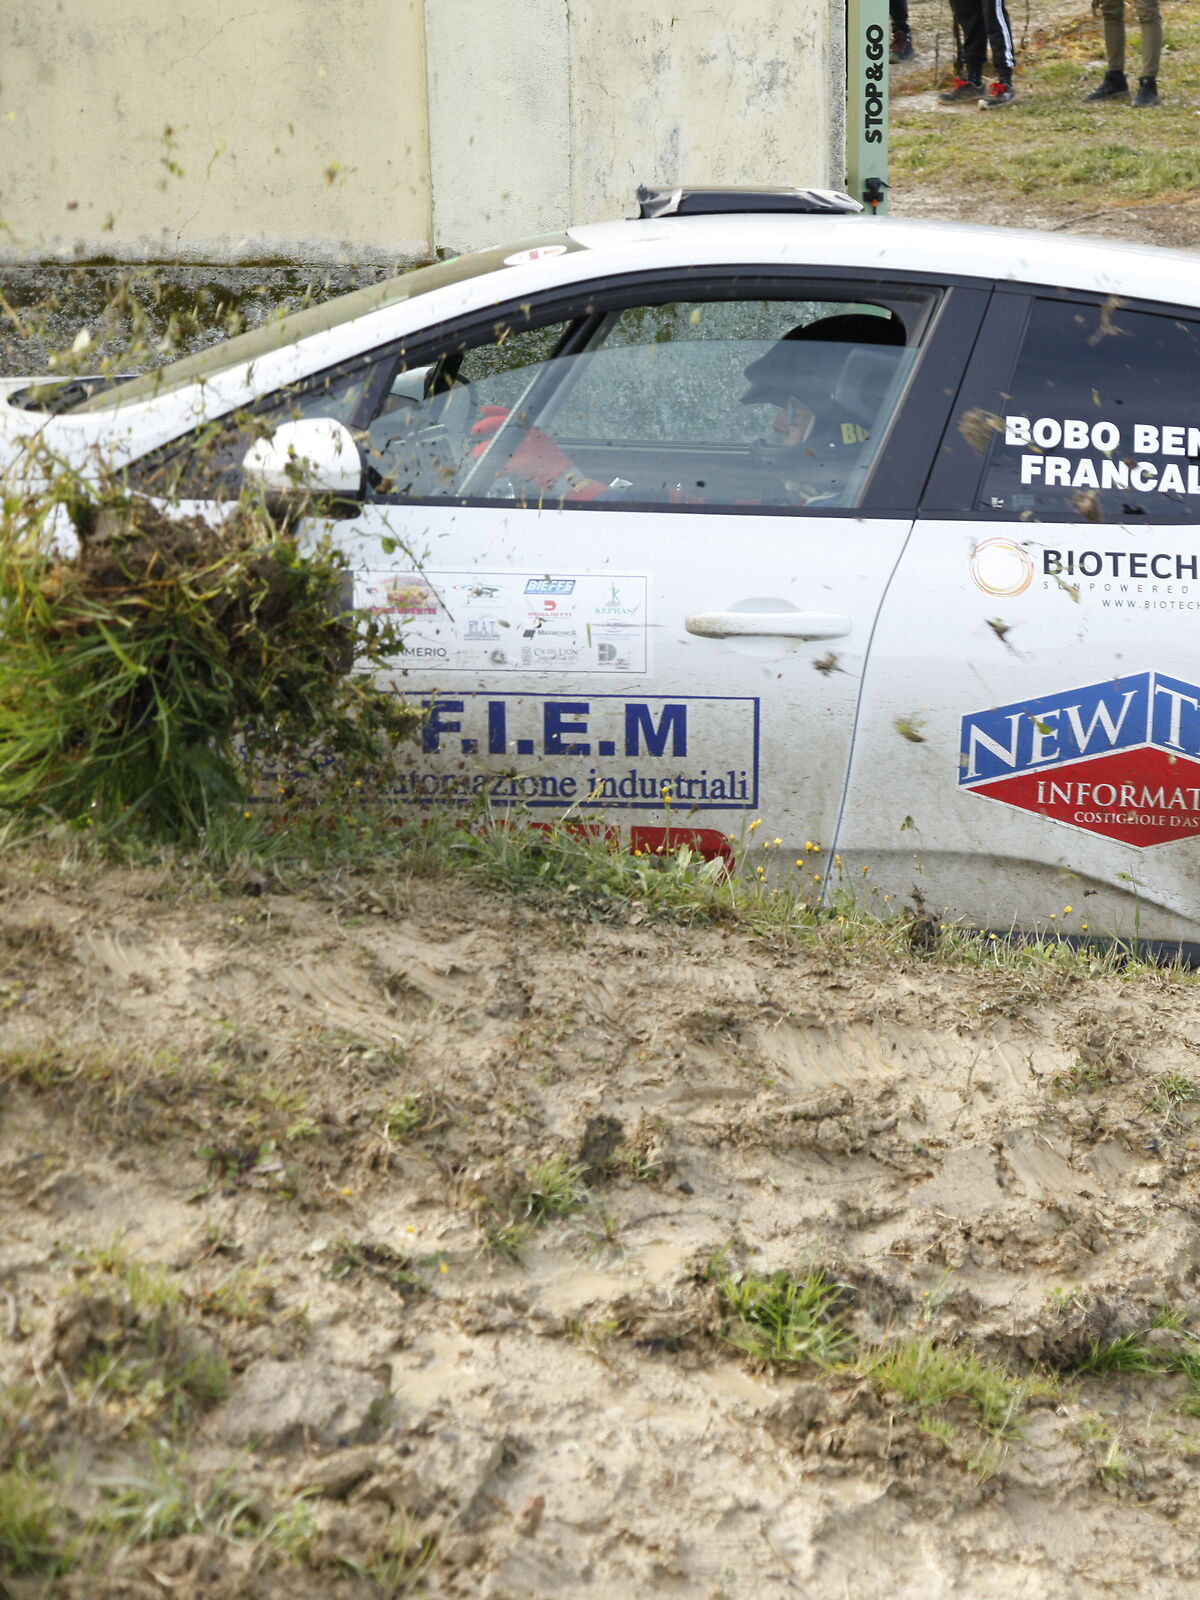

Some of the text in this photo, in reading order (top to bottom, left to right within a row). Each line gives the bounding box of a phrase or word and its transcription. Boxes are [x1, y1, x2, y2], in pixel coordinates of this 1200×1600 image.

[865, 24, 884, 144] STOP & GO
[1005, 415, 1121, 453] BOBO
[527, 580, 575, 592] BIEFFE
[421, 700, 688, 757] F.I.E.M
[961, 690, 1139, 781] NEW
[380, 768, 577, 798] utomazione
[587, 769, 750, 800] industriali
[1074, 811, 1166, 826] COSTIGLIOLE
